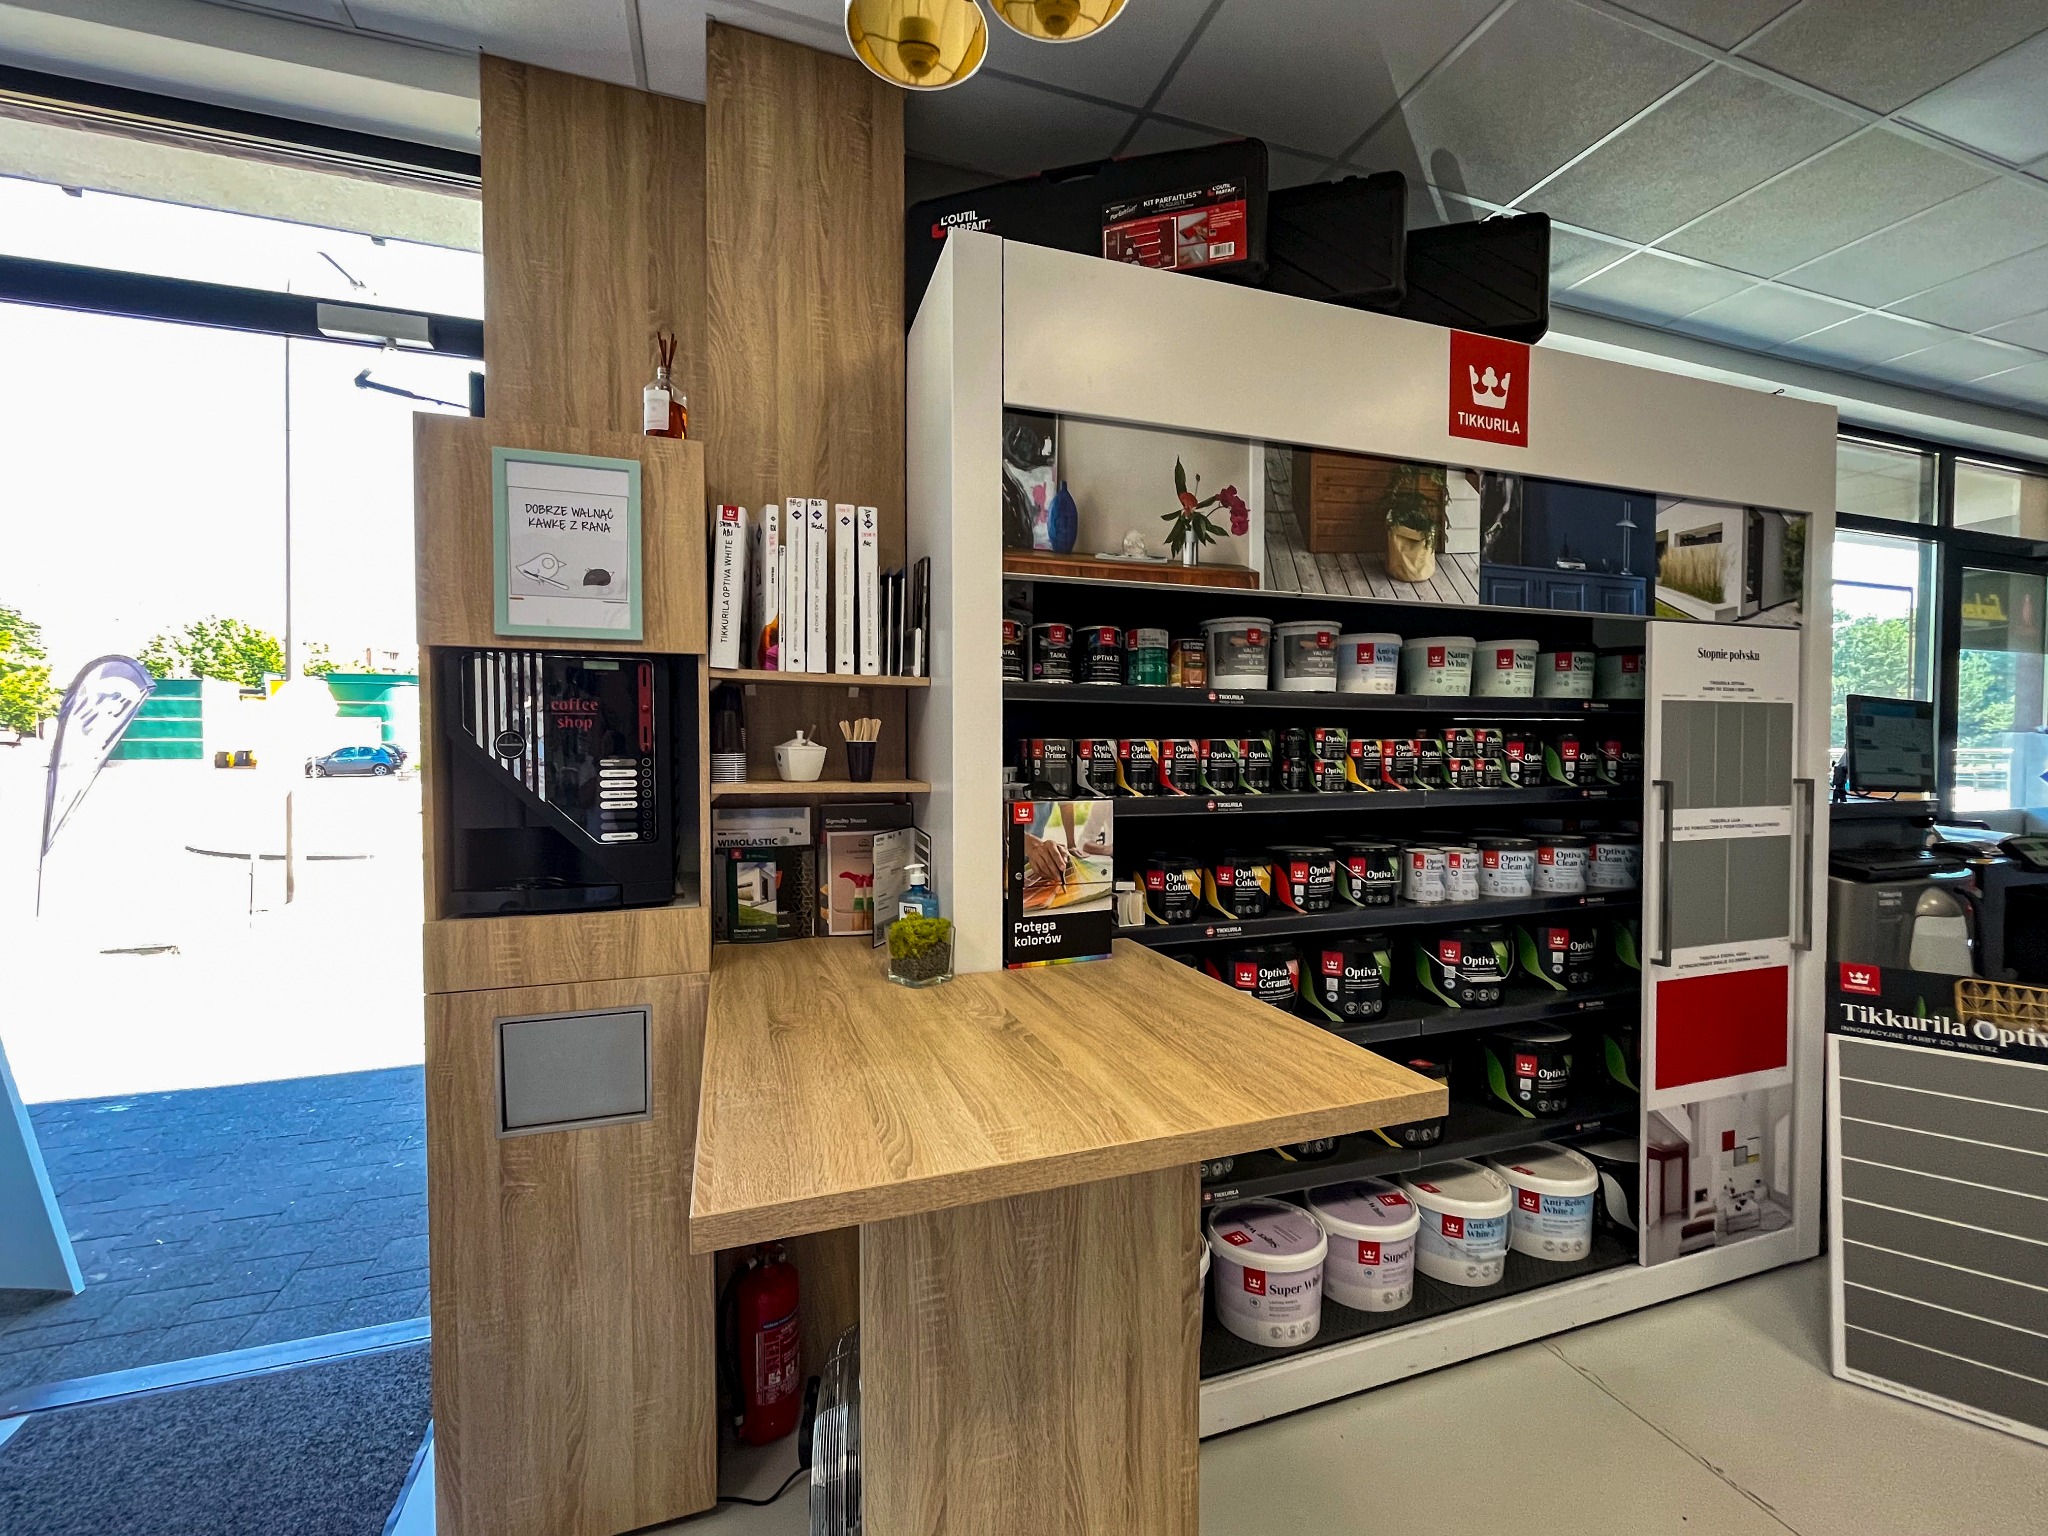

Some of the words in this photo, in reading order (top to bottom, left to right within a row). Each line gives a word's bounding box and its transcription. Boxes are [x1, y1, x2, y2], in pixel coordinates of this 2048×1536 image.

[1143, 199, 1154, 208] KIT
[940, 210, 978, 227] L'OUTIL
[1457, 411, 1520, 434] TIKKURILA
[525, 503, 568, 516] DOBRZE
[571, 507, 614, 522] WALNĄĆ
[528, 517, 567, 531] KAWKĘ
[569, 520, 577, 530] Z
[581, 521, 611, 534] RANA
[724, 540, 734, 566] WHITE
[723, 569, 733, 598] OPTIVA
[720, 600, 731, 643] TIKKURILA
[1049, 651, 1068, 660] TAIKA
[1092, 654, 1113, 663] OPTIVA
[1447, 650, 1471, 660] Nature
[1697, 648, 1728, 662] Stopnie
[1447, 659, 1468, 668] White
[550, 698, 600, 713] coffee
[556, 715, 594, 734] shop
[1045, 744, 1067, 753] Optiva
[1045, 752, 1068, 760] Primer
[1093, 752, 1113, 760] White
[1210, 751, 1232, 760] Optiva
[717, 837, 778, 847] WIMOLASTIC
[1555, 851, 1582, 861] Optiva
[1598, 847, 1626, 857] Optiva
[1501, 854, 1527, 865] Optiva
[1555, 859, 1578, 868] Clean
[1598, 855, 1624, 864] Clean
[1500, 862, 1522, 871] Clean
[1366, 870, 1391, 882] Optiva
[1014, 921, 1057, 936] Potęga
[1014, 934, 1062, 948] kolorów
[1462, 955, 1494, 969] Optiva
[1494, 954, 1500, 965] 5
[1259, 968, 1286, 980] Optiva
[1345, 967, 1376, 981] Optiva
[1377, 966, 1383, 977] 5
[1259, 977, 1292, 989] Ceramic
[1839, 1002, 1967, 1038] Tikkurila
[1839, 1024, 1905, 1041] INNOWACYJNE
[1906, 1034, 1937, 1045] FARBY
[1940, 1039, 1955, 1048] DO
[1538, 1069, 1566, 1081] Optiva
[1544, 1206, 1568, 1217] White
[1569, 1207, 1575, 1217] 2
[1467, 1229, 1490, 1240] White
[1382, 1251, 1410, 1266] Super
[1268, 1283, 1302, 1298] Super
